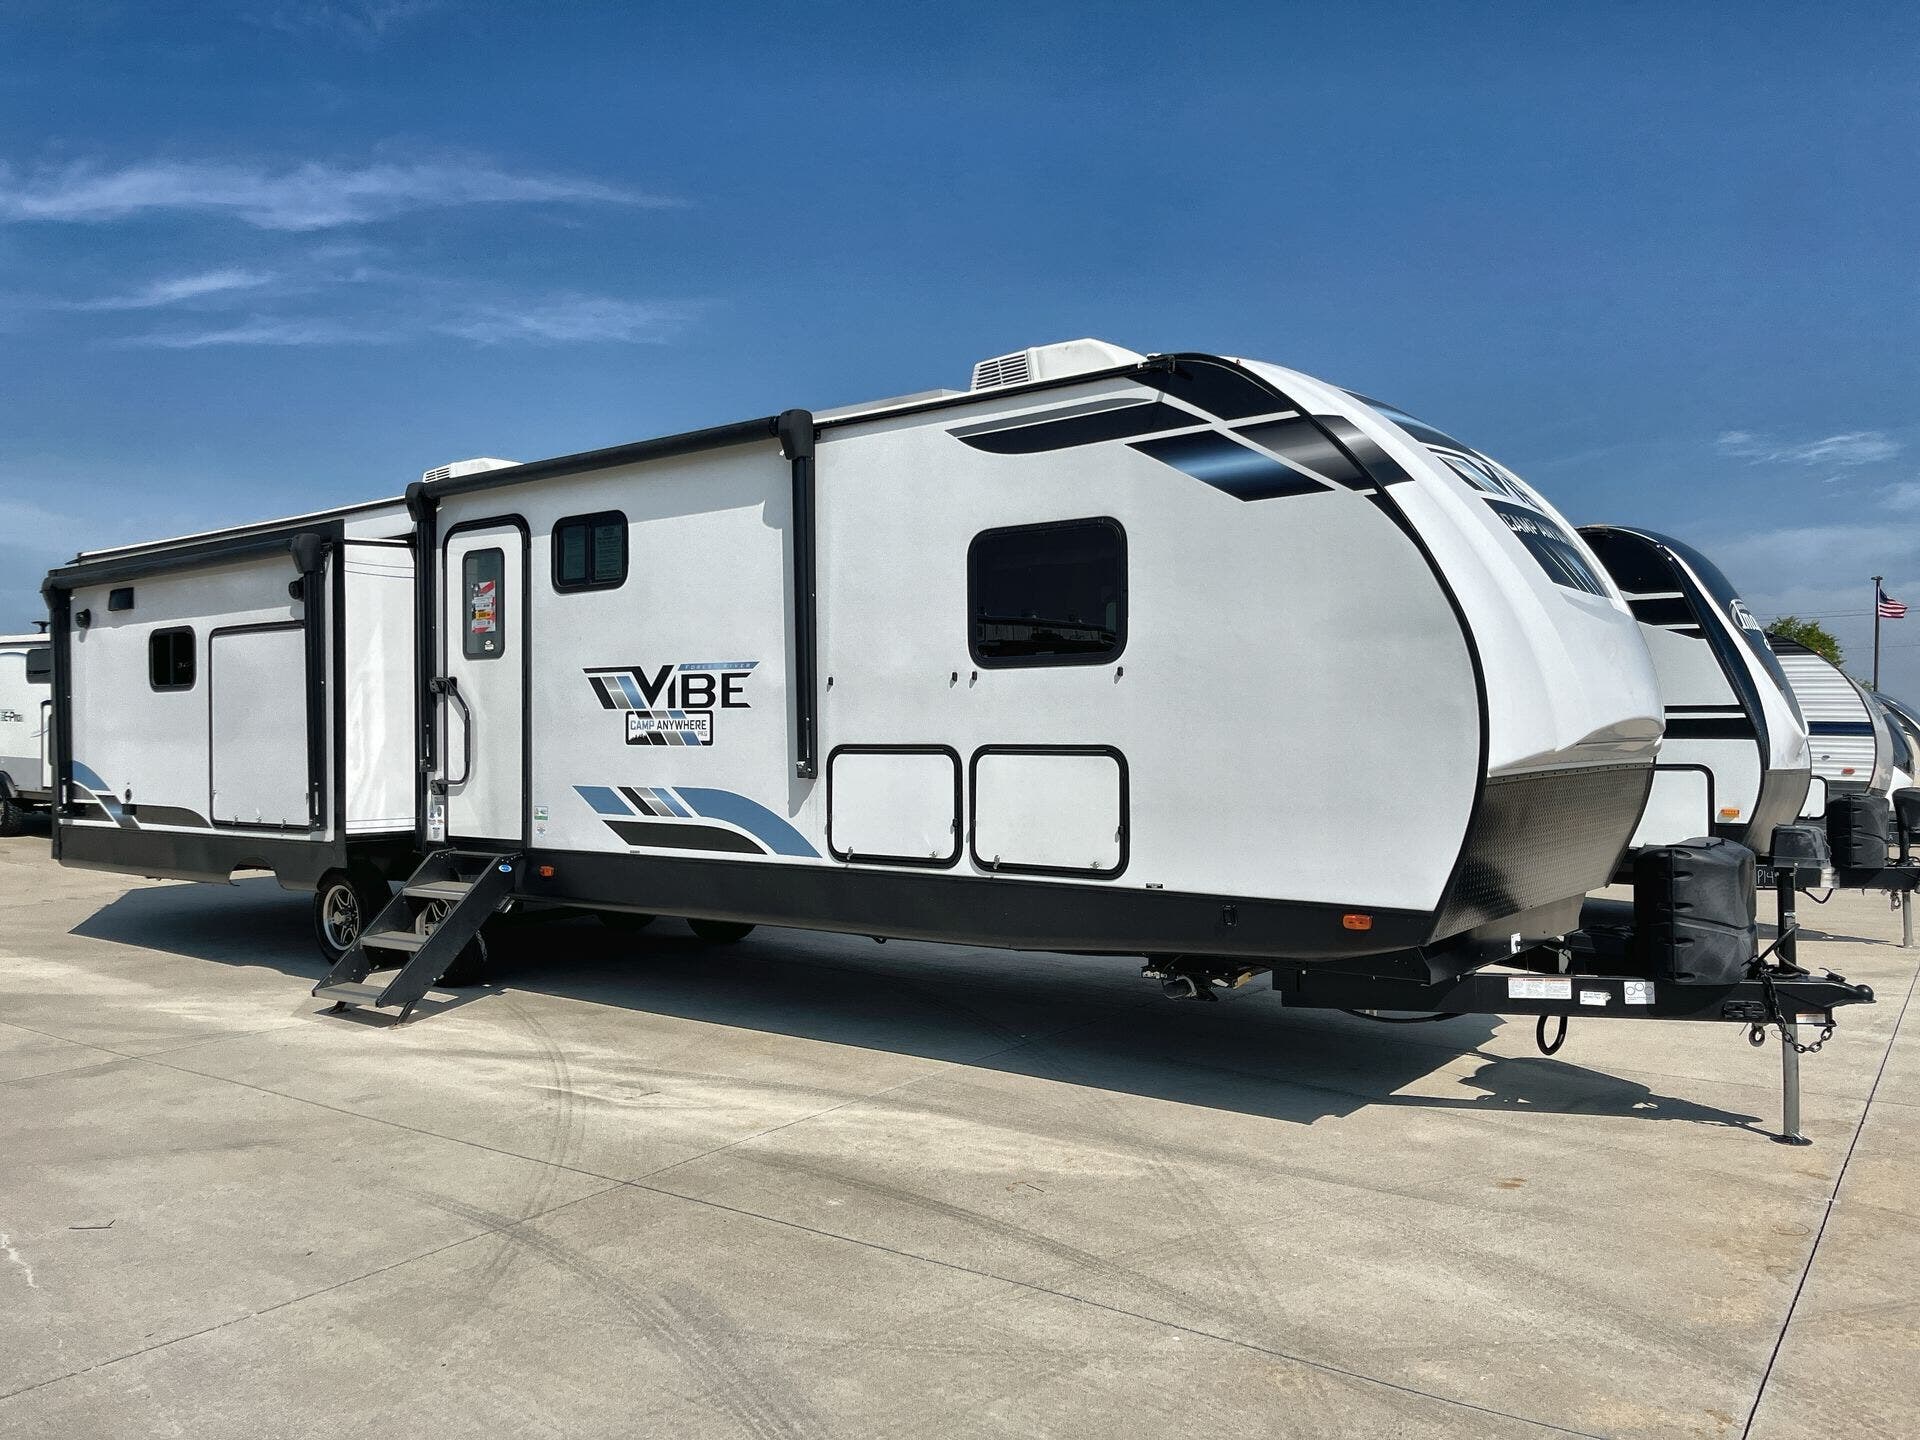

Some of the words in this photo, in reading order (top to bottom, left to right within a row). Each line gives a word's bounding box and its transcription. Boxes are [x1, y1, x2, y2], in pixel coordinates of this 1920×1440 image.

[608, 664, 752, 709] VIBE
[630, 719, 655, 731] CAMP
[656, 719, 707, 731] ANYWHERE
